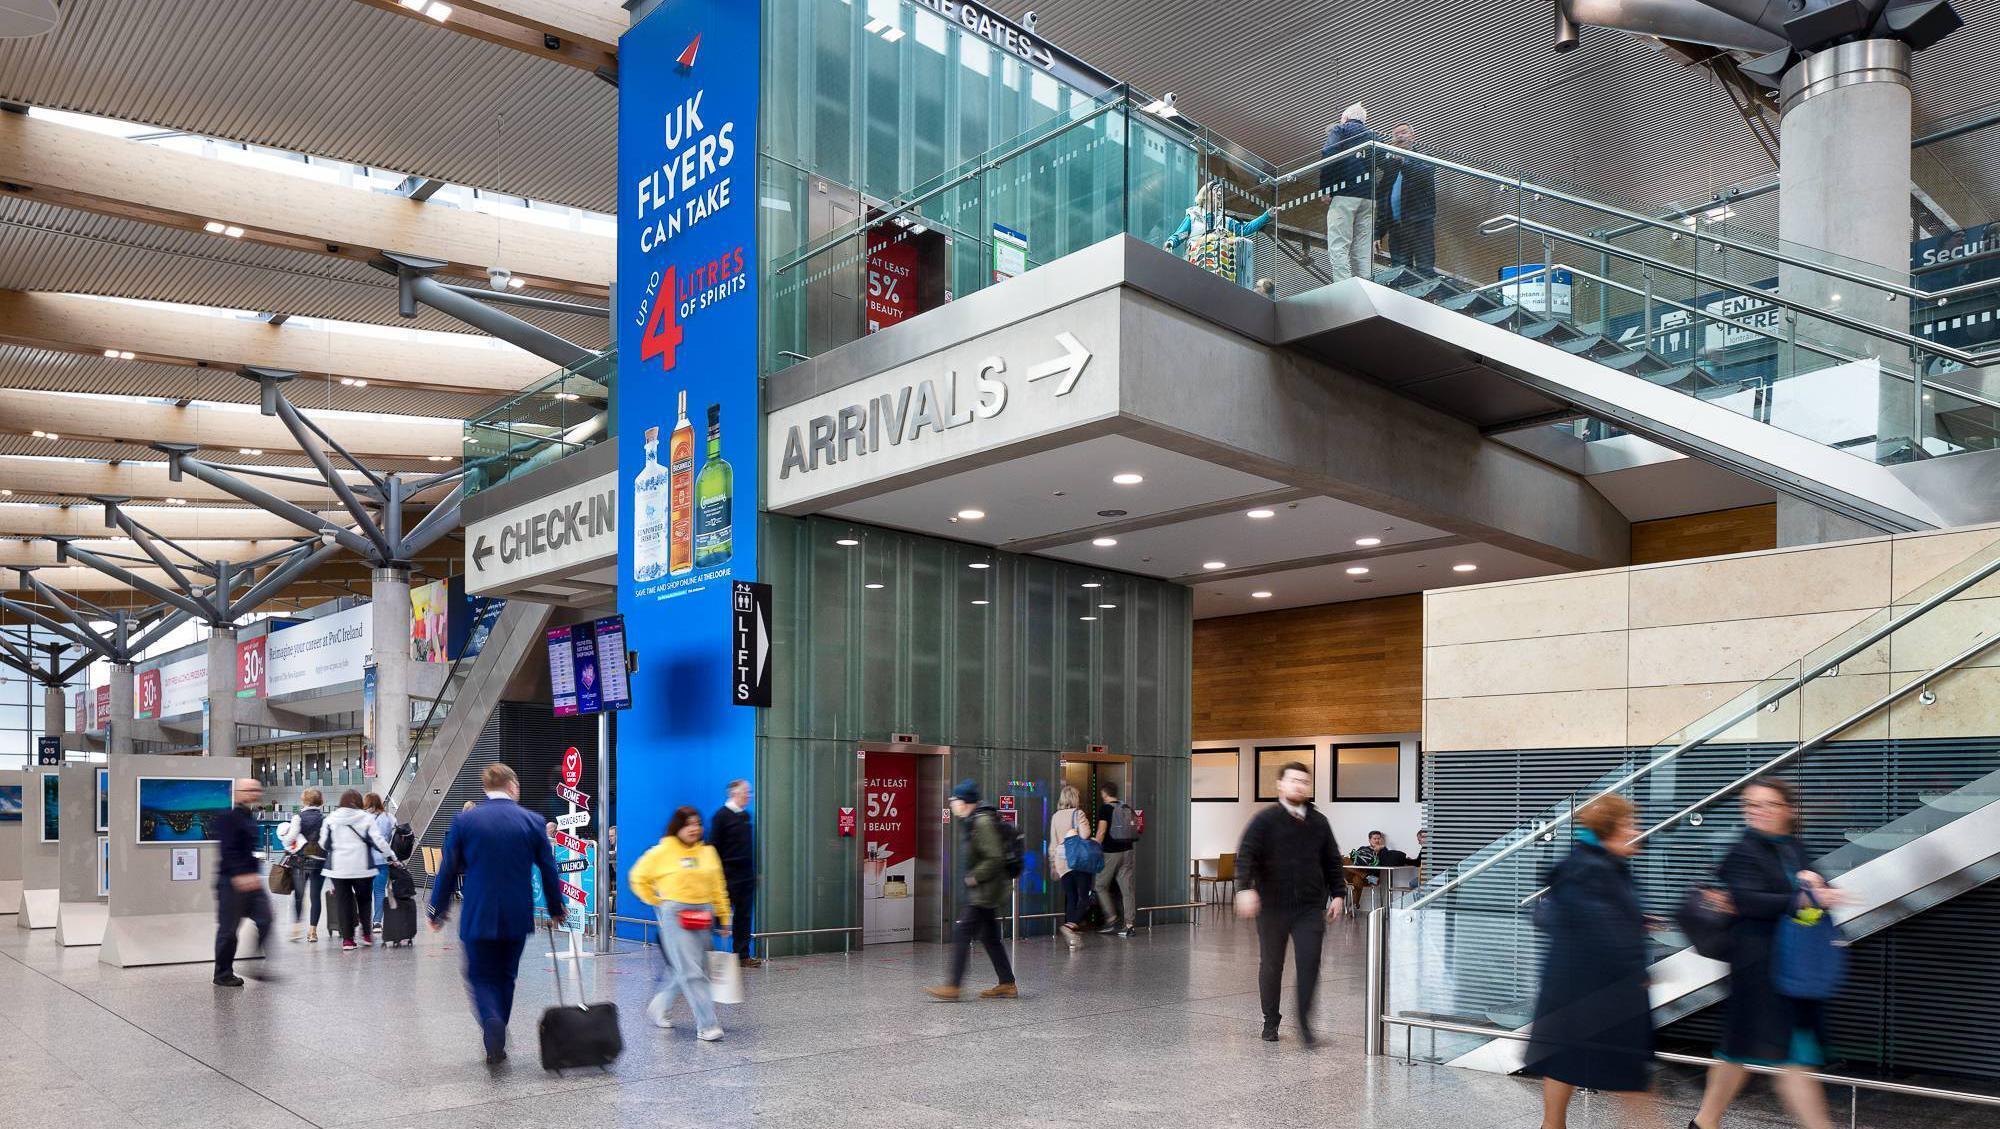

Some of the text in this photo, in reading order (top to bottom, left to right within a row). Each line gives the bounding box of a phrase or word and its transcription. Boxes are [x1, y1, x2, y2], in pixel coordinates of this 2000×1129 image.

[961, 4, 1032, 58] GATES
[665, 89, 704, 150] UK
[638, 122, 735, 220] FLYERS
[640, 177, 731, 253] CAN TAKE
[872, 257, 882, 268] AT
[884, 259, 911, 277] LEAST
[1922, 233, 2000, 267] Securi
[678, 246, 744, 302] LITRES
[635, 271, 660, 327] UP TO
[681, 273, 746, 318] OF SPIRITS
[870, 302, 904, 319] BEAUTY
[641, 264, 683, 371] 4
[779, 356, 1009, 480] ARRIVALS
[499, 489, 616, 565] CHECK-IN
[635, 588, 646, 598] SAVE
[646, 585, 656, 595] TIME
[656, 583, 667, 592] AND
[667, 580, 679, 590] SHOP
[679, 577, 697, 587] ONLINE
[697, 575, 703, 583] AT
[269, 643, 294, 661] Reimagine
[293, 641, 305, 658] your
[305, 637, 322, 652] career
[322, 634, 329, 647] at
[329, 629, 342, 645] PwC
[342, 622, 363, 642] Ireland
[737, 616, 749, 700] LIFTS
[243, 648, 264, 685] 30%
[563, 788, 580, 804] ROME
[870, 778, 881, 787] AT
[883, 778, 908, 788] LEAST
[560, 814, 587, 826] NEWCASTLE
[869, 822, 901, 831] BEAUTY
[564, 836, 580, 851] FARO
[561, 861, 585, 872] VALENCIA
[563, 884, 580, 900] PARIS
